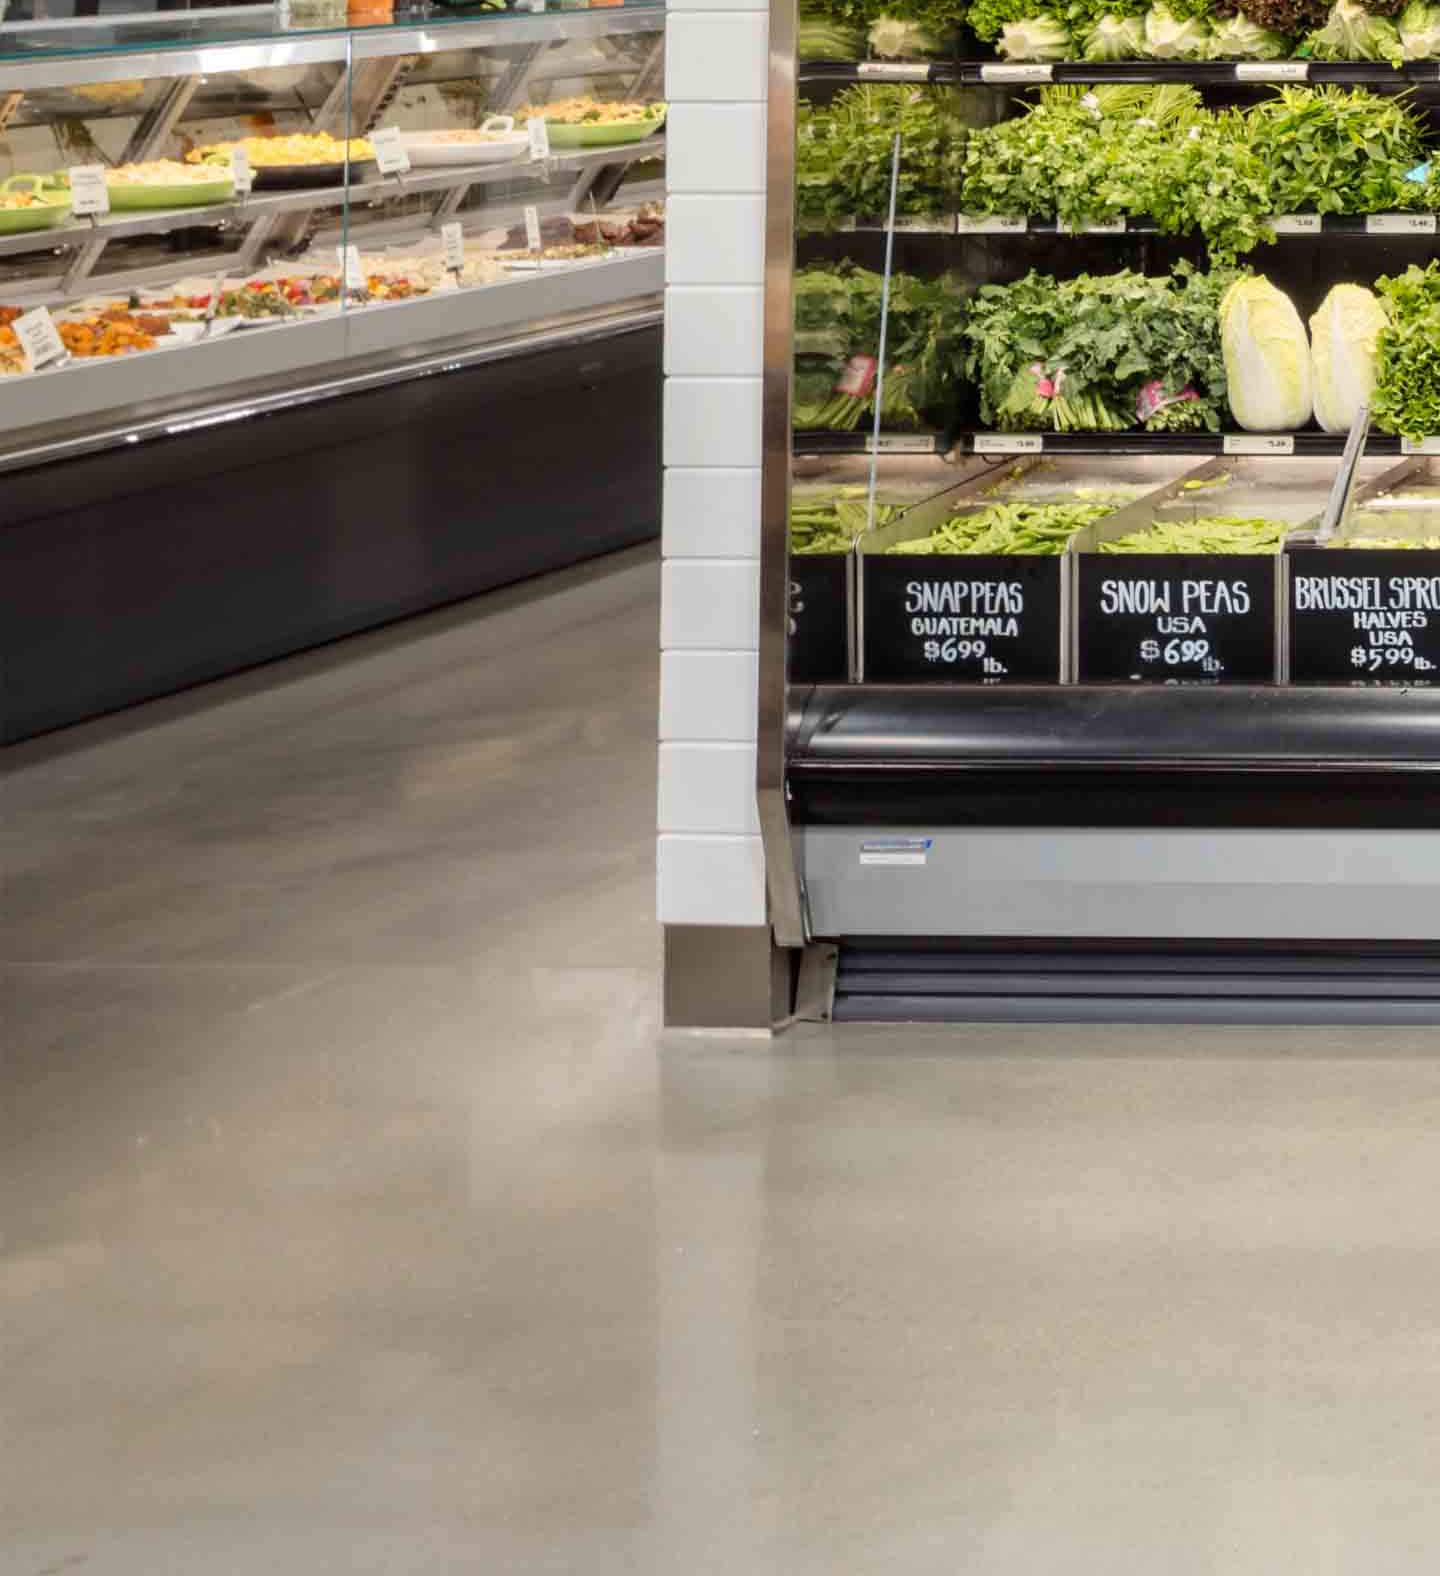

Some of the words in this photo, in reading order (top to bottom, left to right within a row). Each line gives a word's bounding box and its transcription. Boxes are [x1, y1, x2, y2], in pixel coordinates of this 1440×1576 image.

[905, 581, 974, 615] SNAP
[975, 581, 1024, 615] PEAS
[1100, 580, 1171, 615] SNOW
[1182, 580, 1251, 615] PEAS
[1295, 576, 1388, 611] BRUSSEL
[911, 617, 1019, 637] GUATEMALA
[1156, 615, 1207, 634] USA
[1352, 610, 1428, 629] HALVES
[1369, 631, 1414, 646] USA
